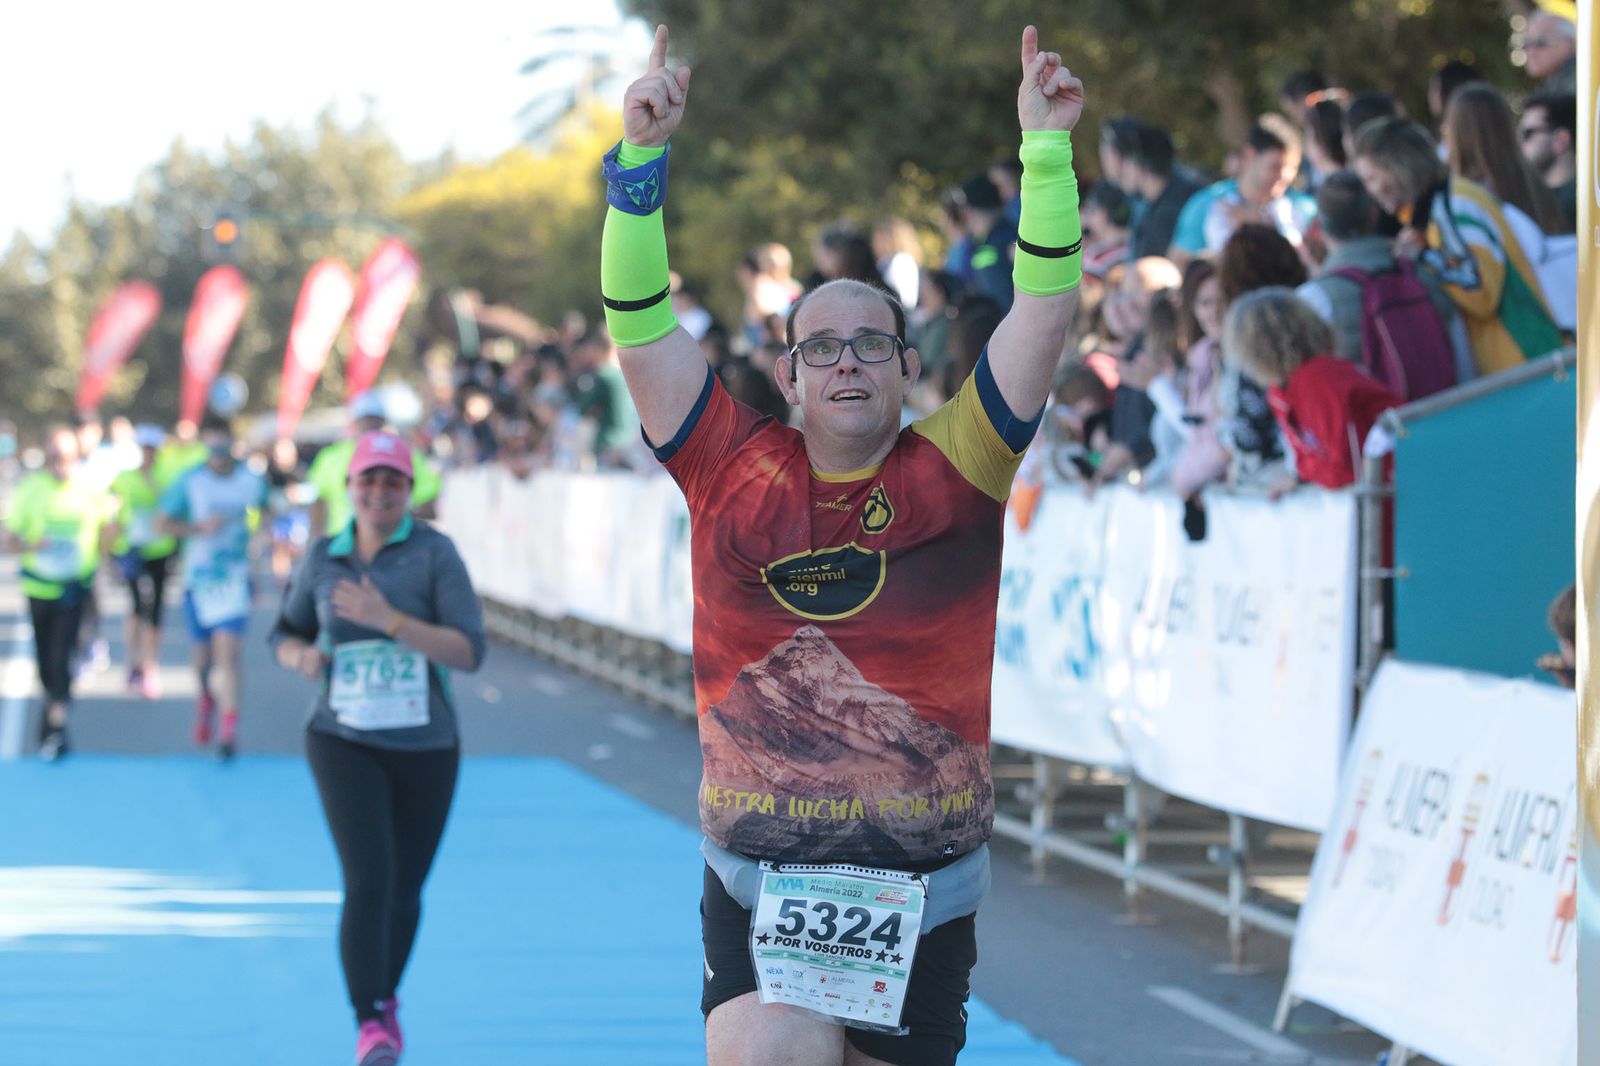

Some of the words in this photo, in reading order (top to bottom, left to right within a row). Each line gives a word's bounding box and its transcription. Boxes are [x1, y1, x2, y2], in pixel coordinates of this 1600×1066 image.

[785, 582, 818, 596] .org
[788, 796, 865, 820] LUCHA
[878, 796, 931, 819] POR
[809, 884, 840, 896] Almería
[775, 898, 902, 951] 5324
[774, 935, 801, 948] POR
[805, 940, 873, 959] VOSOTROS
